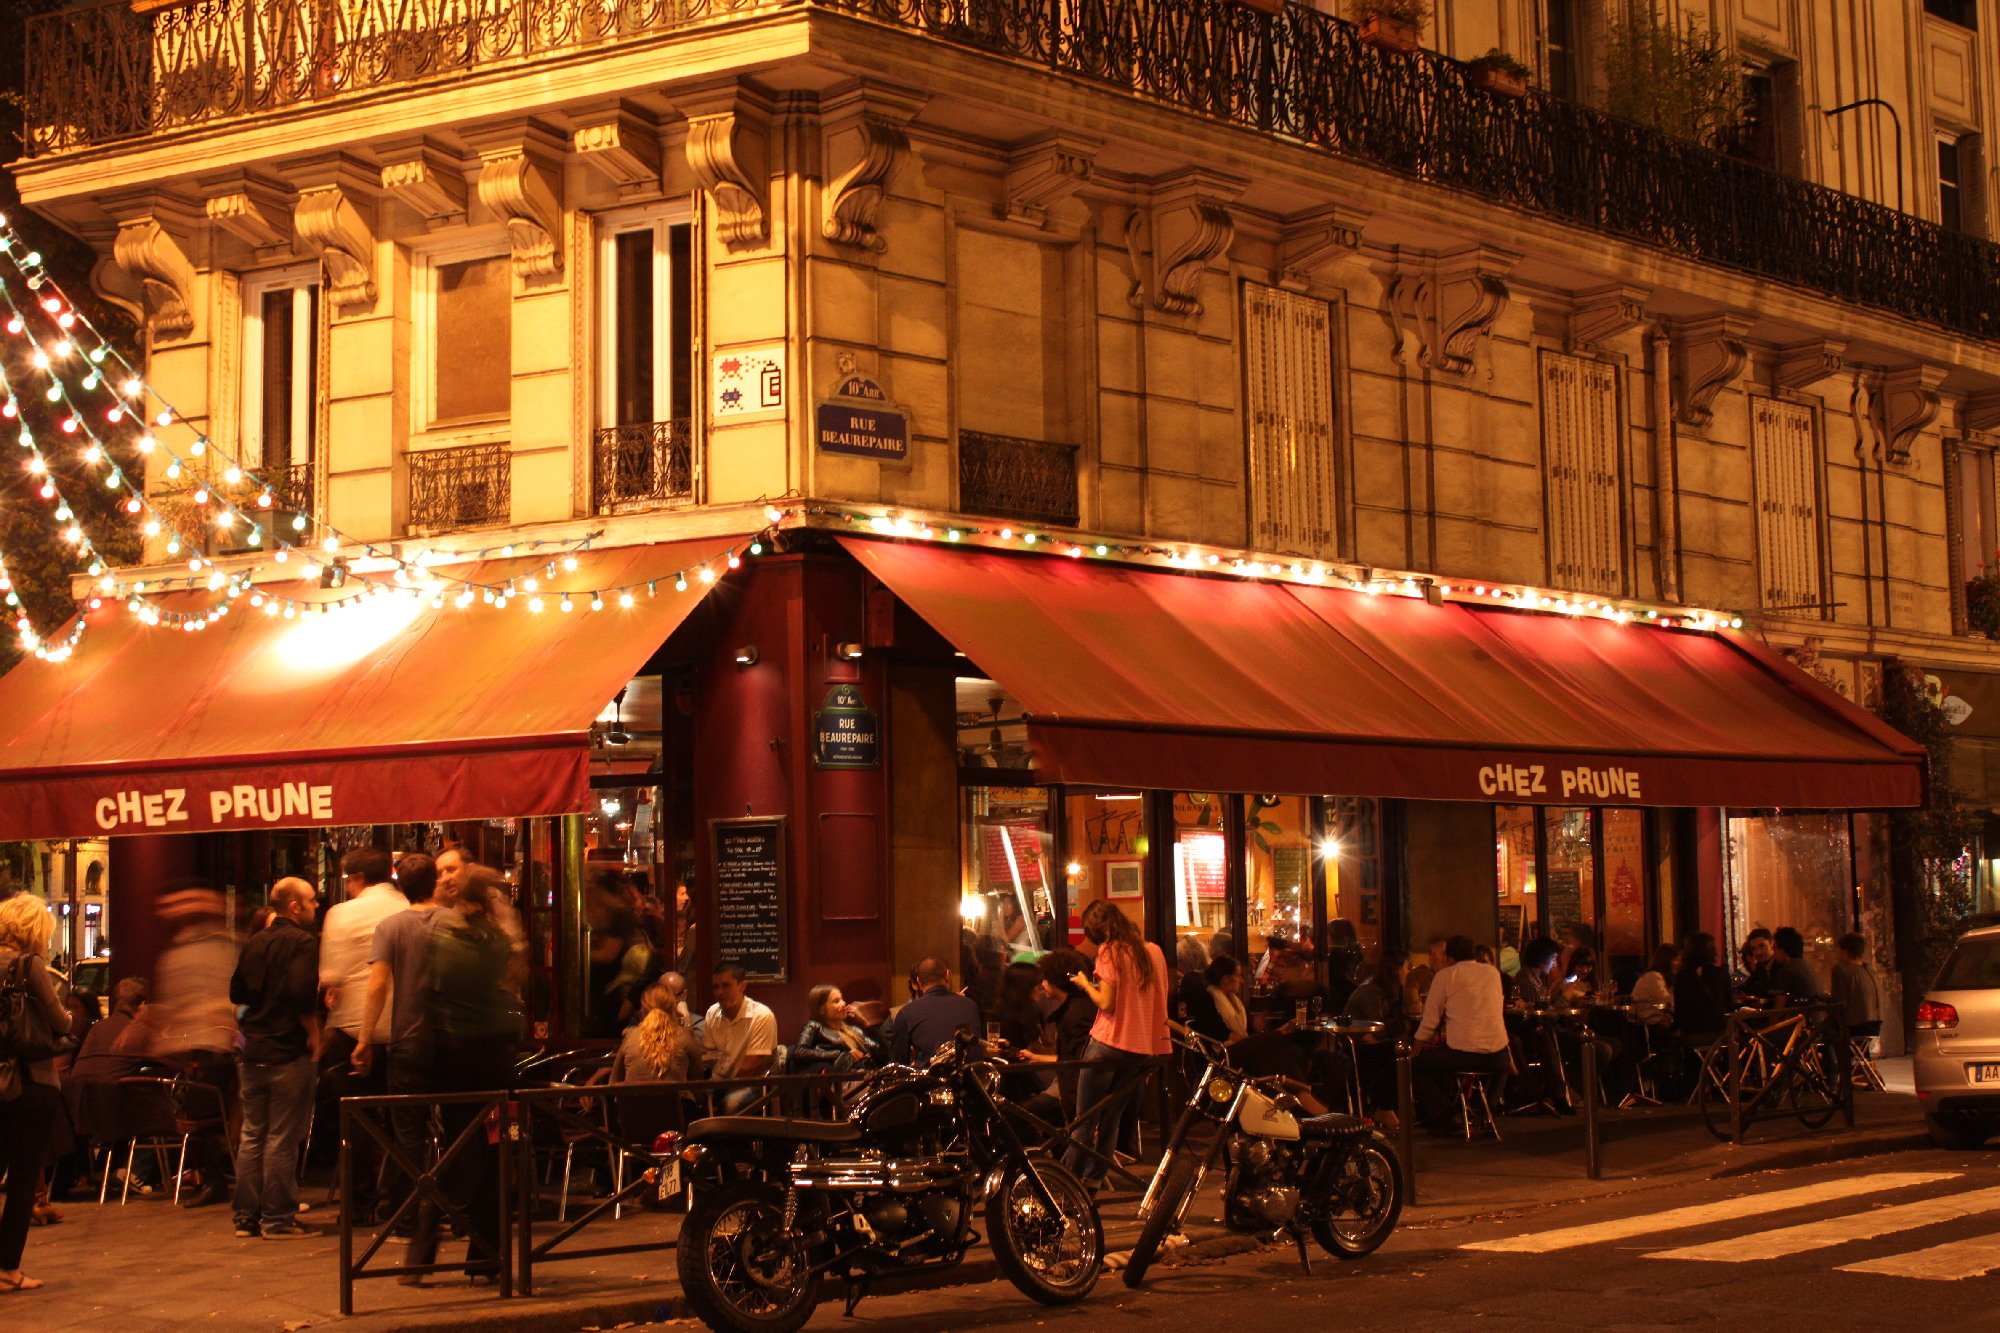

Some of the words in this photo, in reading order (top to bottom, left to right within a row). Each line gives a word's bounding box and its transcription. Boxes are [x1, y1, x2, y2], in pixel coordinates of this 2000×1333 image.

[850, 417, 876, 431] RUE
[822, 430, 904, 452] BEAUREPAIRE
[839, 718, 856, 729] RUE
[819, 732, 875, 744] BEAUREPAIRE
[1478, 763, 1547, 797] CHEZ
[1561, 766, 1642, 799] PRUNE
[95, 788, 190, 830] CHEZ
[209, 781, 333, 824] PRUNE
